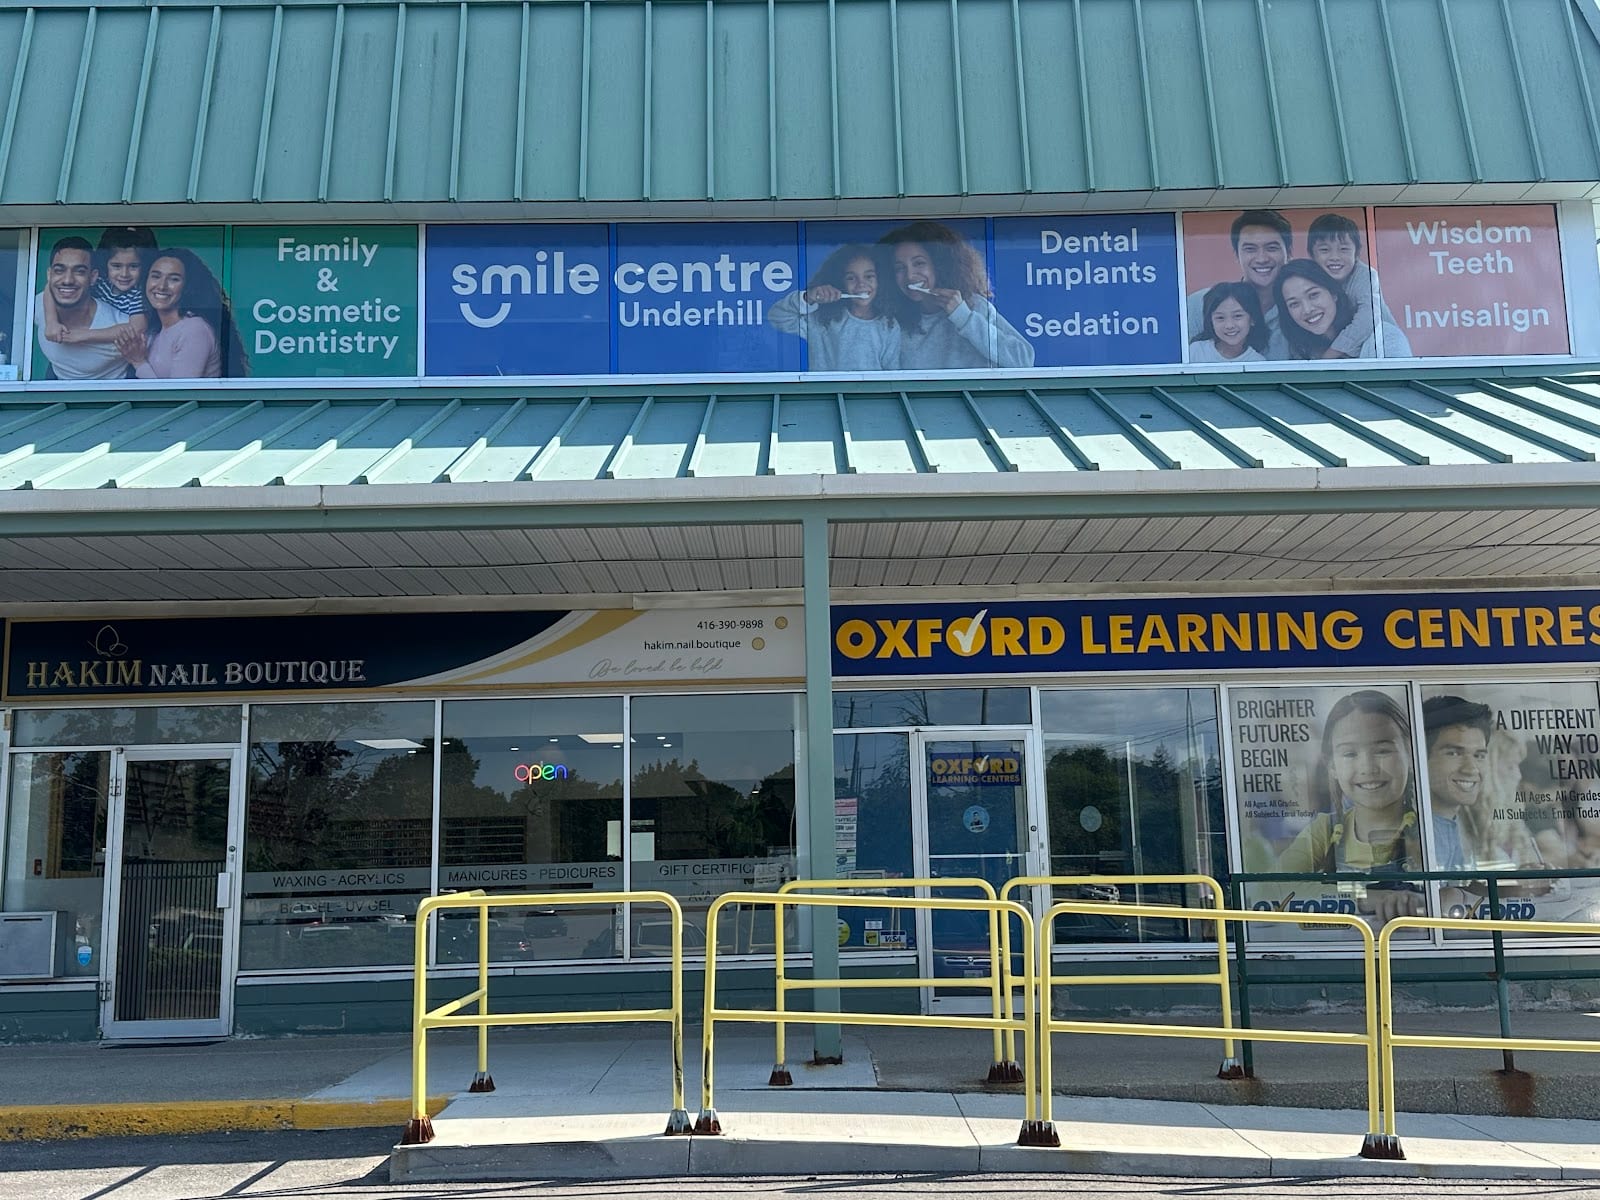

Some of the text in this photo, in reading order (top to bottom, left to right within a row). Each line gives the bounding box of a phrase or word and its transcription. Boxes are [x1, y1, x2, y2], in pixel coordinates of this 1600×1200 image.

[1041, 227, 1138, 254] Dental
[1406, 220, 1532, 245] Wisdom
[278, 236, 379, 267] Family
[1429, 250, 1514, 275] Teeth
[316, 267, 339, 292] &
[451, 250, 793, 296] smile centre
[1026, 260, 1157, 290] Implants
[252, 298, 401, 323] Cosmetic
[618, 300, 762, 327] Underhill
[1405, 302, 1550, 332] Invisalign
[1025, 310, 1159, 337] Sedation
[254, 328, 399, 359] Dentistry
[697, 620, 764, 631] 416-390-9898
[835, 609, 1066, 659] OXFORD
[1081, 609, 1363, 655] LEARNING
[643, 639, 741, 651] hakim.nail.boutique
[26, 660, 367, 688] HAKIM NAIL BOUTIQUE
[589, 658, 621, 679] Be
[669, 657, 688, 672] be
[690, 656, 724, 673] bold
[1237, 699, 1316, 719] BRIGHTER
[1496, 708, 1596, 731] A DIFFERENT
[1239, 724, 1310, 743] FUTURES
[1535, 733, 1599, 755] WAY TO
[931, 755, 1019, 775] OXFORD
[1241, 749, 1288, 768] BEGIN
[1549, 759, 1600, 780] LEARN
[514, 761, 568, 785] open
[932, 774, 1020, 784] LEARNING CENTRES
[1243, 773, 1284, 793] HERE
[1514, 791, 1527, 803] All
[1555, 790, 1567, 802] All
[1493, 808, 1505, 820] All
[1552, 807, 1576, 819] Enrol
[273, 876, 327, 887] WAXING
[338, 873, 406, 885] ACRYLICS
[448, 869, 527, 882] MANICURES
[539, 866, 616, 880] PEDICURES
[659, 864, 688, 876] GIFT
[346, 901, 365, 912] UV
[368, 899, 395, 911] GEL
[885, 935, 902, 943] VISA
